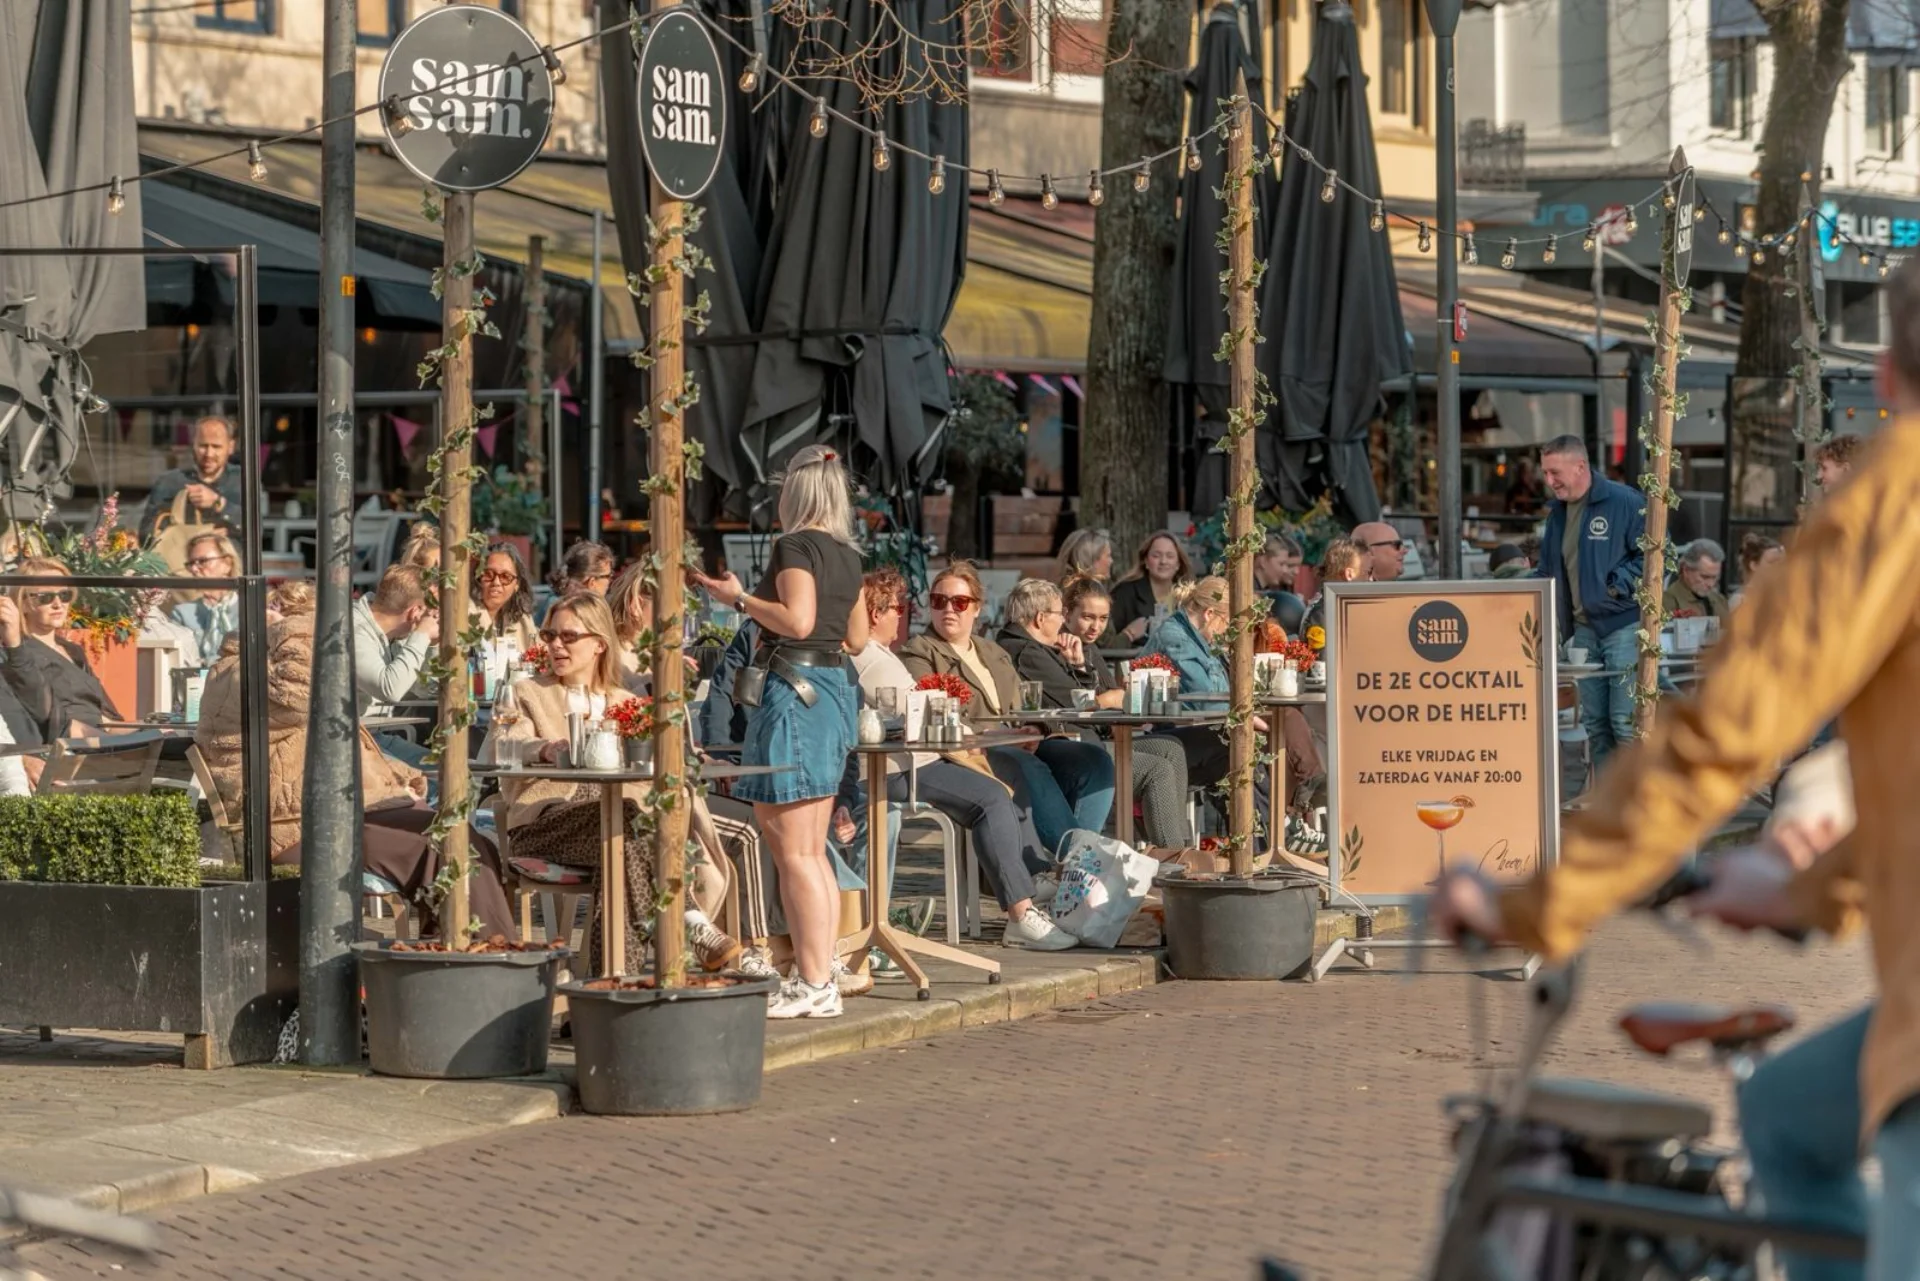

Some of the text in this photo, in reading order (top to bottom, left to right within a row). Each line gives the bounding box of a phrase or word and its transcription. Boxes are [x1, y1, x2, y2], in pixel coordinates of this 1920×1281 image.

[411, 58, 524, 101] sam
[652, 65, 711, 107] sam
[408, 95, 532, 138] sam.
[652, 103, 716, 146] sam.
[1417, 618, 1458, 632] sam
[1417, 631, 1462, 645] sam.
[1356, 671, 1524, 690] DE 2E COCKTAIL
[1354, 703, 1527, 723] VOOR DE HELFT!
[1381, 749, 1498, 762] ELKE VRIJDAG EN
[1358, 770, 1522, 784] ZATERDAG VANAF 20:00
